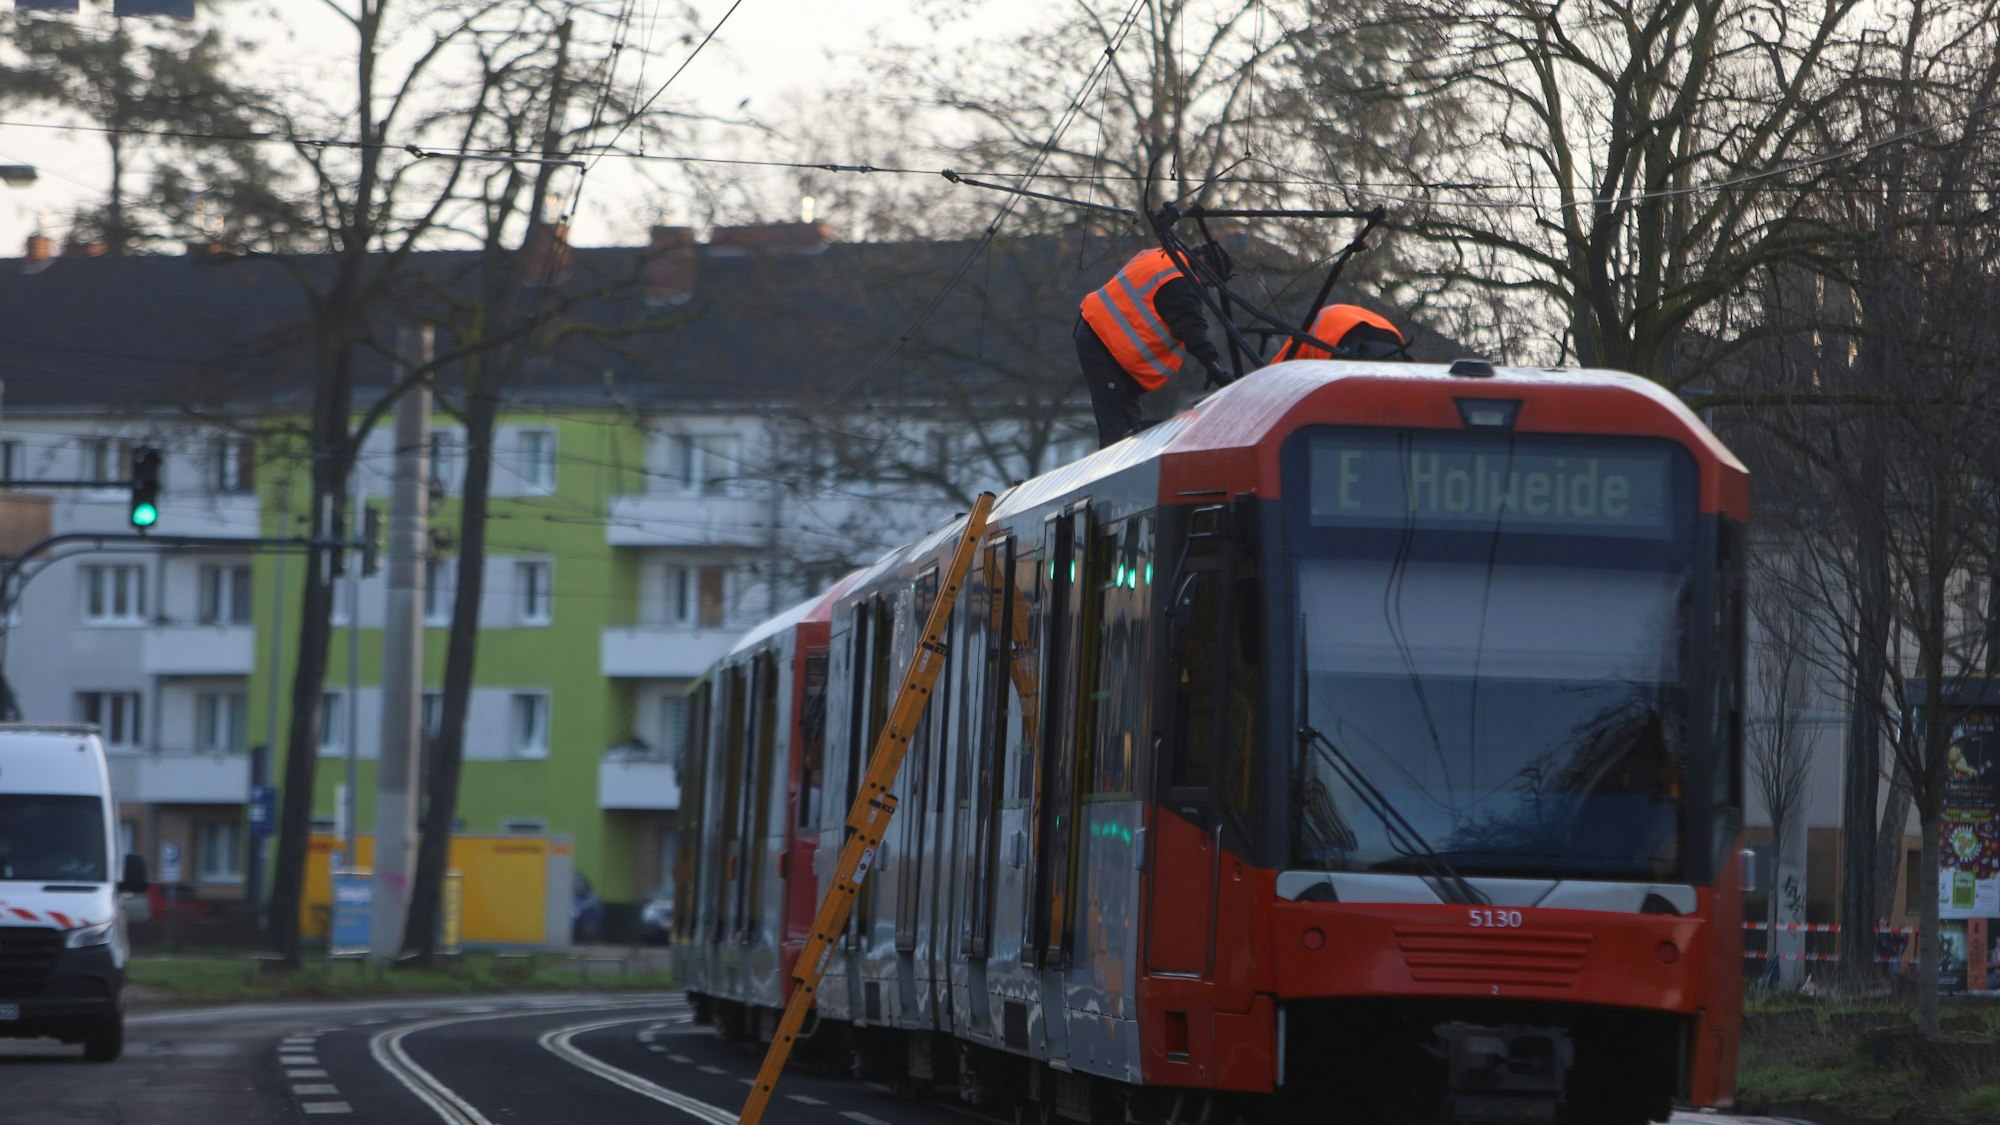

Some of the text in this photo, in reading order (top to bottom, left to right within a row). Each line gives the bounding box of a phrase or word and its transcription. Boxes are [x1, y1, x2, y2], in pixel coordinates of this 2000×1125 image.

[1339, 450, 1630, 518] E Holweide
[1469, 910, 1522, 927] 5130
[1491, 985, 1499, 995] 2
